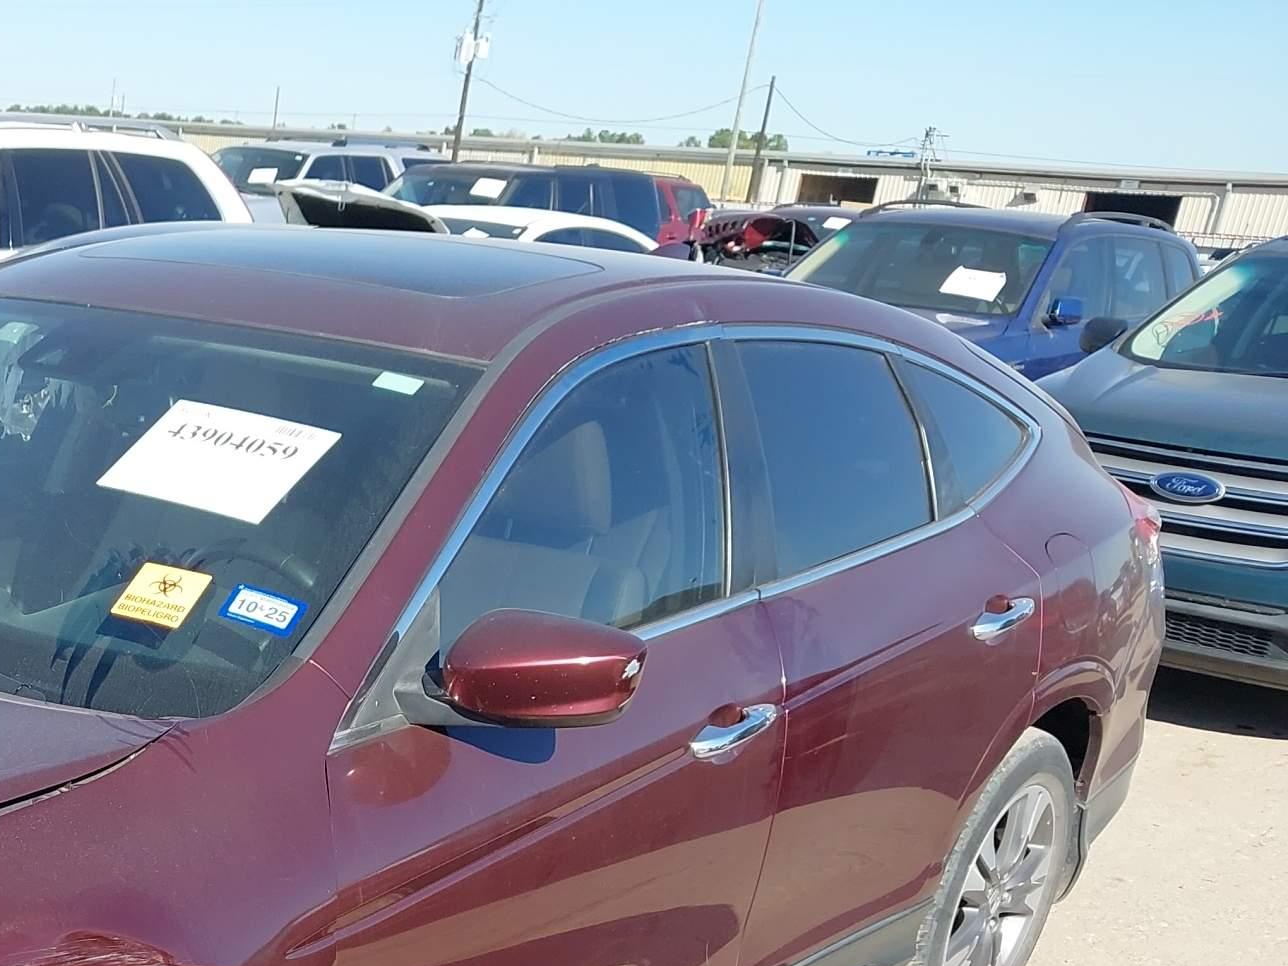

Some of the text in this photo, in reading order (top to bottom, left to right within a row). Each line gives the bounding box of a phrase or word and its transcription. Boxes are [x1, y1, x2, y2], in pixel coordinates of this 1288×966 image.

[168, 423, 298, 459] 43904059
[1166, 476, 1207, 494] Ford
[117, 602, 179, 623] BIOPELIGRO
[123, 594, 186, 613] BIOHAZARD
